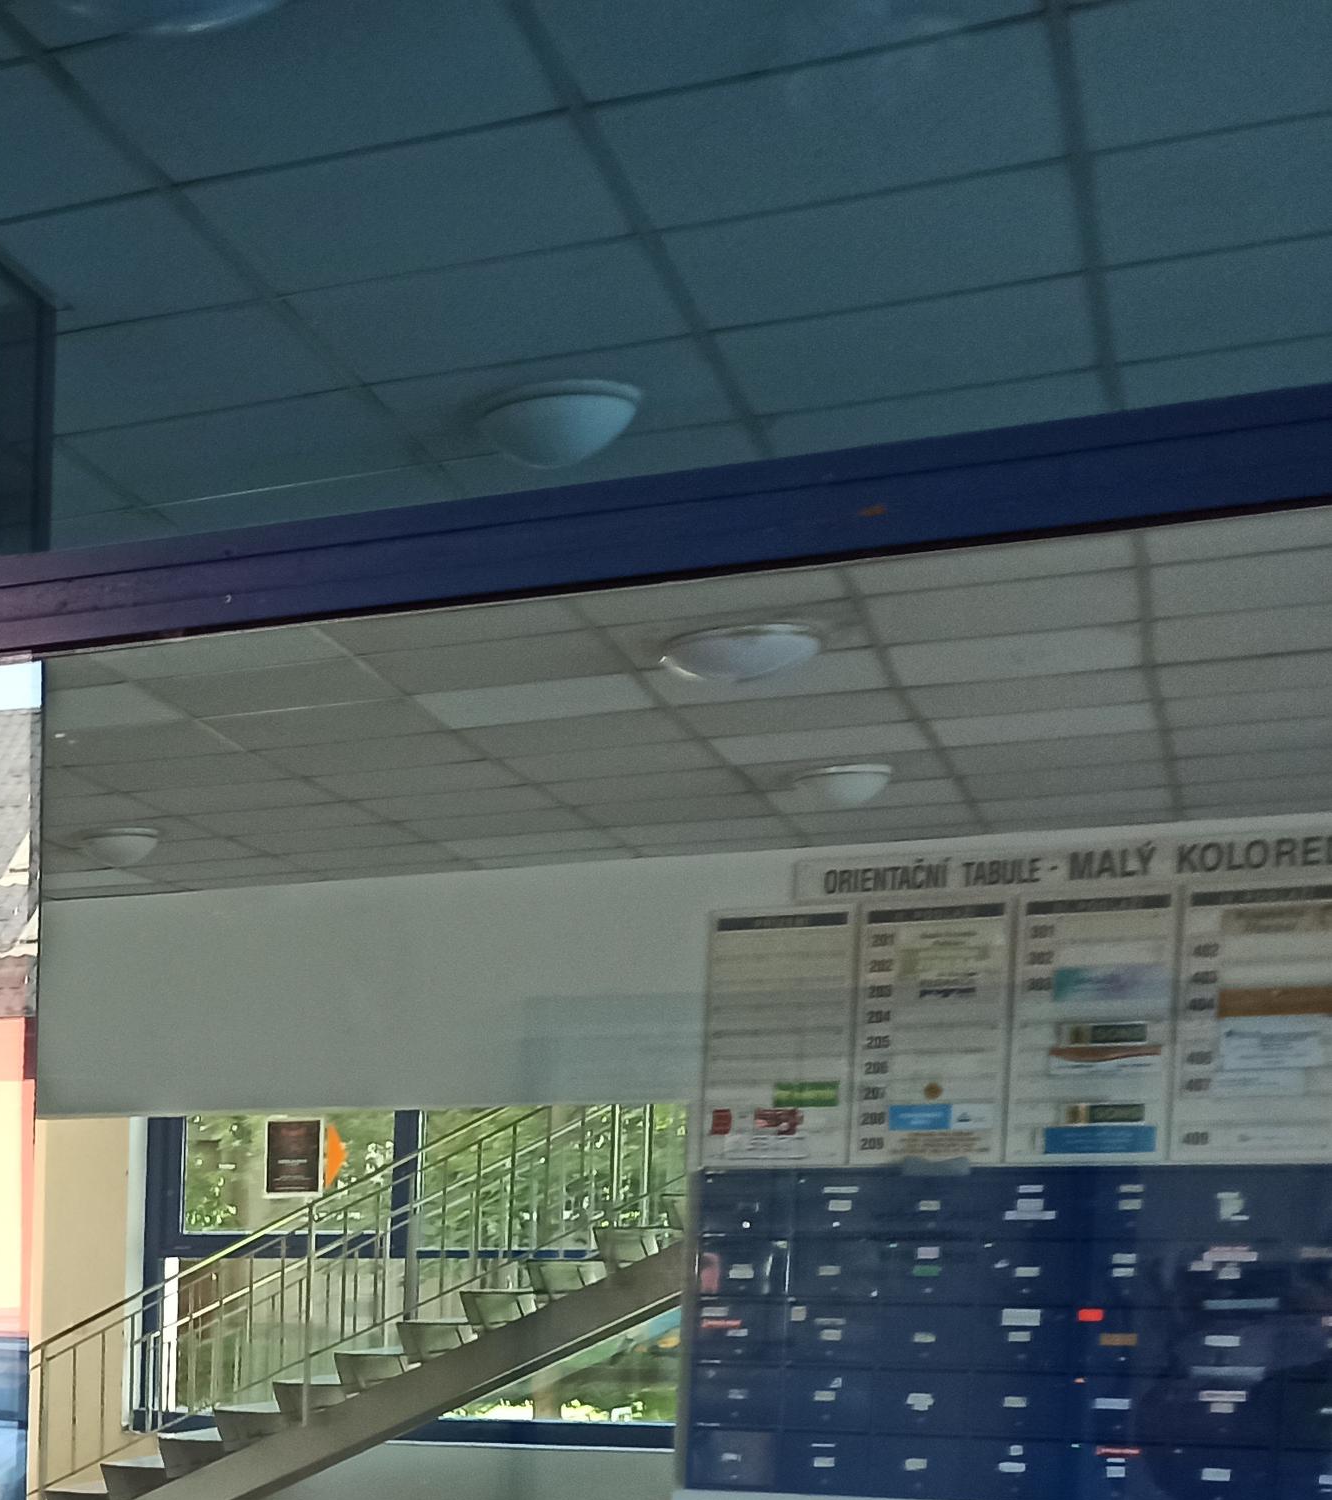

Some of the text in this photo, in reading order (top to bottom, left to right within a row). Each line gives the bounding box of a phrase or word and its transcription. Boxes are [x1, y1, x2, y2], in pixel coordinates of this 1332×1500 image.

[824, 857, 950, 894] ORIENTAČNÍ
[962, 857, 1042, 886] TABULE
[1069, 840, 1156, 880] MALÝ
[866, 1010, 891, 1024] 204
[865, 1035, 891, 1049] 205
[860, 1137, 884, 1151] 209
